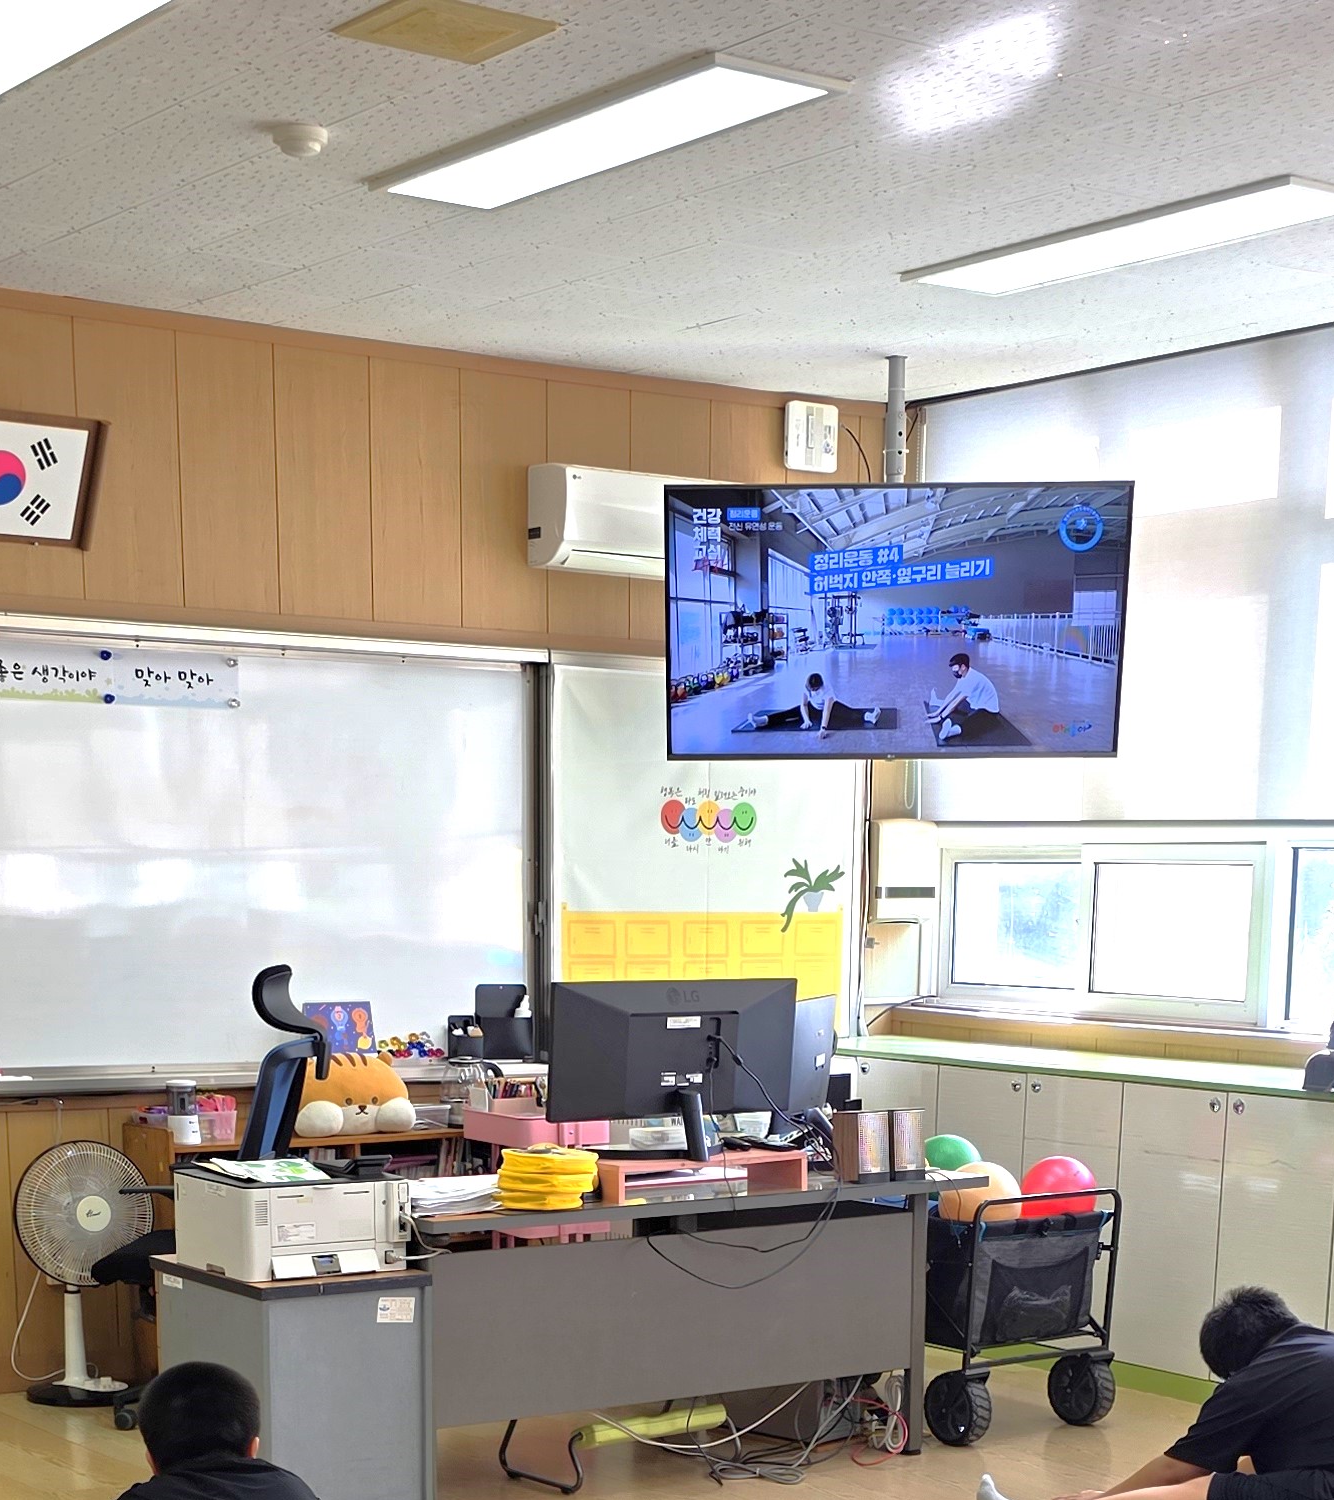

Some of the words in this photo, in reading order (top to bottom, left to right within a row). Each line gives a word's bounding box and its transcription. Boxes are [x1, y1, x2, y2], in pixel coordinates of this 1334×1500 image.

[693, 508, 722, 524] 건강
[693, 526, 721, 542] 체력
[693, 544, 721, 560] 교실
[814, 549, 874, 570] 정리운동
[877, 547, 899, 564] #4
[814, 573, 858, 592] 허벅지
[945, 559, 990, 579] 늘리기
[31, 664, 97, 684] 생각이야
[135, 667, 172, 687] 맞아
[178, 669, 214, 689] 맞아
[683, 990, 699, 1003] LG
